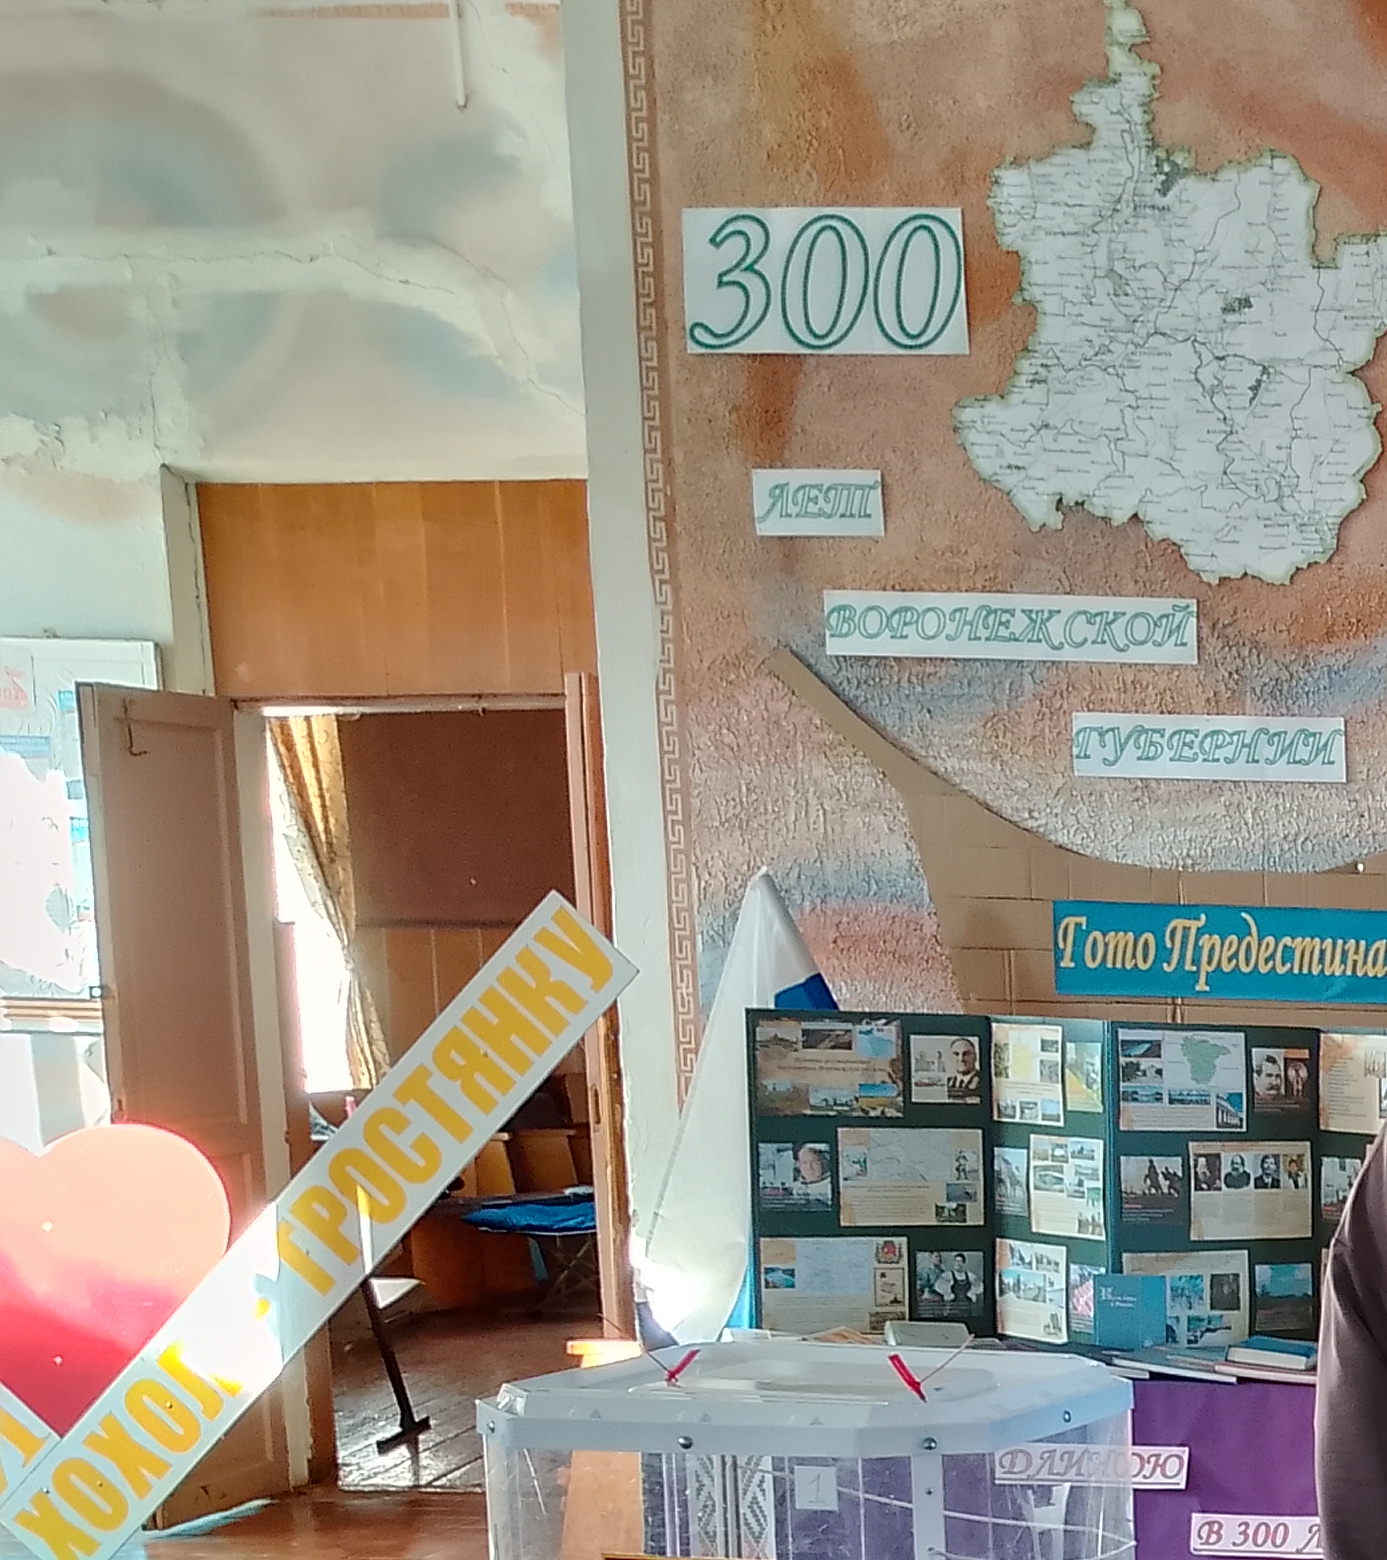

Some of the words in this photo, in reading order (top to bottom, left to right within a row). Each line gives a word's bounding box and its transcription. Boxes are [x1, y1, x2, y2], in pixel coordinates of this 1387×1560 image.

[689, 214, 965, 350] 300
[757, 479, 879, 523] ЛЕТ
[826, 603, 1198, 652] ВОРОНЕЖСКОЙ
[1073, 725, 1344, 767] ГУБЕРНИИ
[1057, 915, 1155, 969] Гото
[1196, 1520, 1223, 1546] В
[1231, 1521, 1291, 1548] 300
